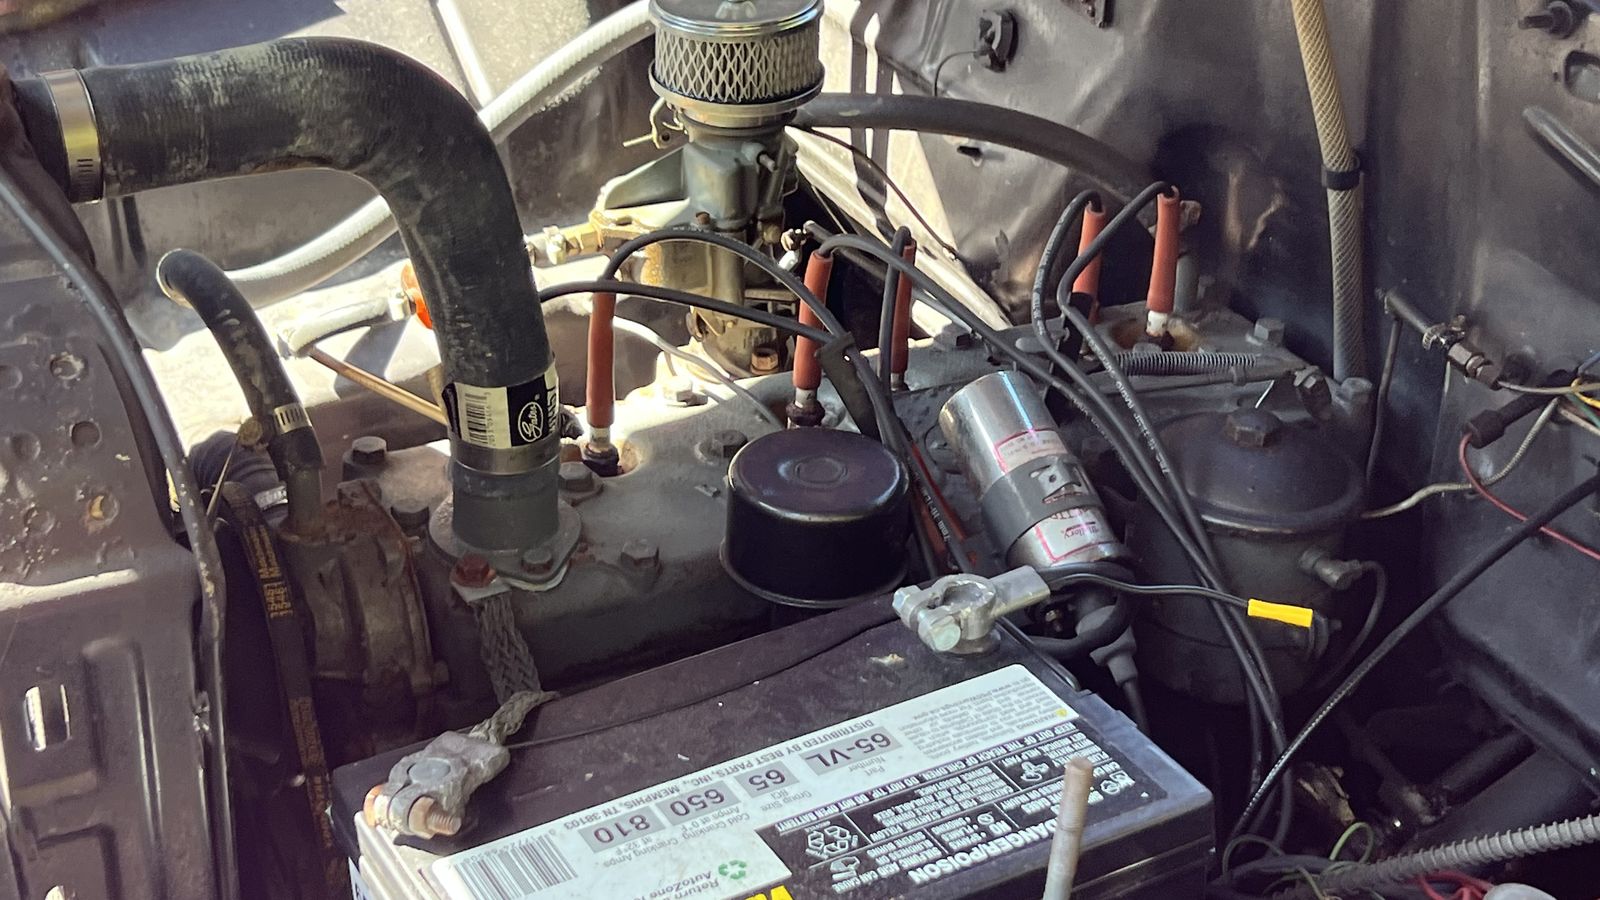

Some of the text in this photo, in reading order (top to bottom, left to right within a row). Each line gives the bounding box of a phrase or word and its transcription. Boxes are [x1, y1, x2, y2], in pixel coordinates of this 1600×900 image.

[1063, 523, 1098, 540] Mllory
[800, 719, 874, 748] DISTRIBUTED
[1033, 729, 1055, 740] OUT
[1051, 722, 1077, 734] KEEP
[1003, 740, 1024, 751] THE
[1020, 735, 1038, 745] OF
[752, 749, 784, 764] BEST
[782, 743, 802, 754] BY
[804, 731, 894, 770] 65-VL
[975, 747, 1004, 761] REACH
[710, 758, 754, 778] PARTS,
[845, 755, 886, 773] Number
[962, 755, 979, 766] OF
[863, 765, 885, 776] Part
[745, 768, 788, 791] 65
[883, 781, 906, 793] NOT
[902, 776, 920, 786] DO
[666, 787, 727, 817] 650
[759, 789, 813, 812] Group Size
[836, 798, 857, 810] NOT
[852, 793, 870, 804] DO
[599, 805, 619, 817] TN
[709, 804, 741, 820] Amps
[813, 804, 840, 818] OPEN
[561, 811, 602, 829] 38103
[680, 812, 751, 840] Cold Cranking
[698, 816, 712, 825] at
[986, 819, 1012, 835] NO
[590, 813, 652, 844] 810
[867, 824, 903, 841] FOLLOW
[939, 825, 975, 841] FLAMES
[640, 835, 654, 845] at
[892, 831, 926, 848] SEVERE
[946, 832, 983, 850] SPARKS
[600, 836, 679, 868] Cranking Amps
[905, 818, 1058, 884] DANGER/POISON
[830, 846, 942, 893] SULFURIC ACID CAN CAUSE
[646, 870, 716, 900] AutoZone
[671, 878, 722, 900] Return
